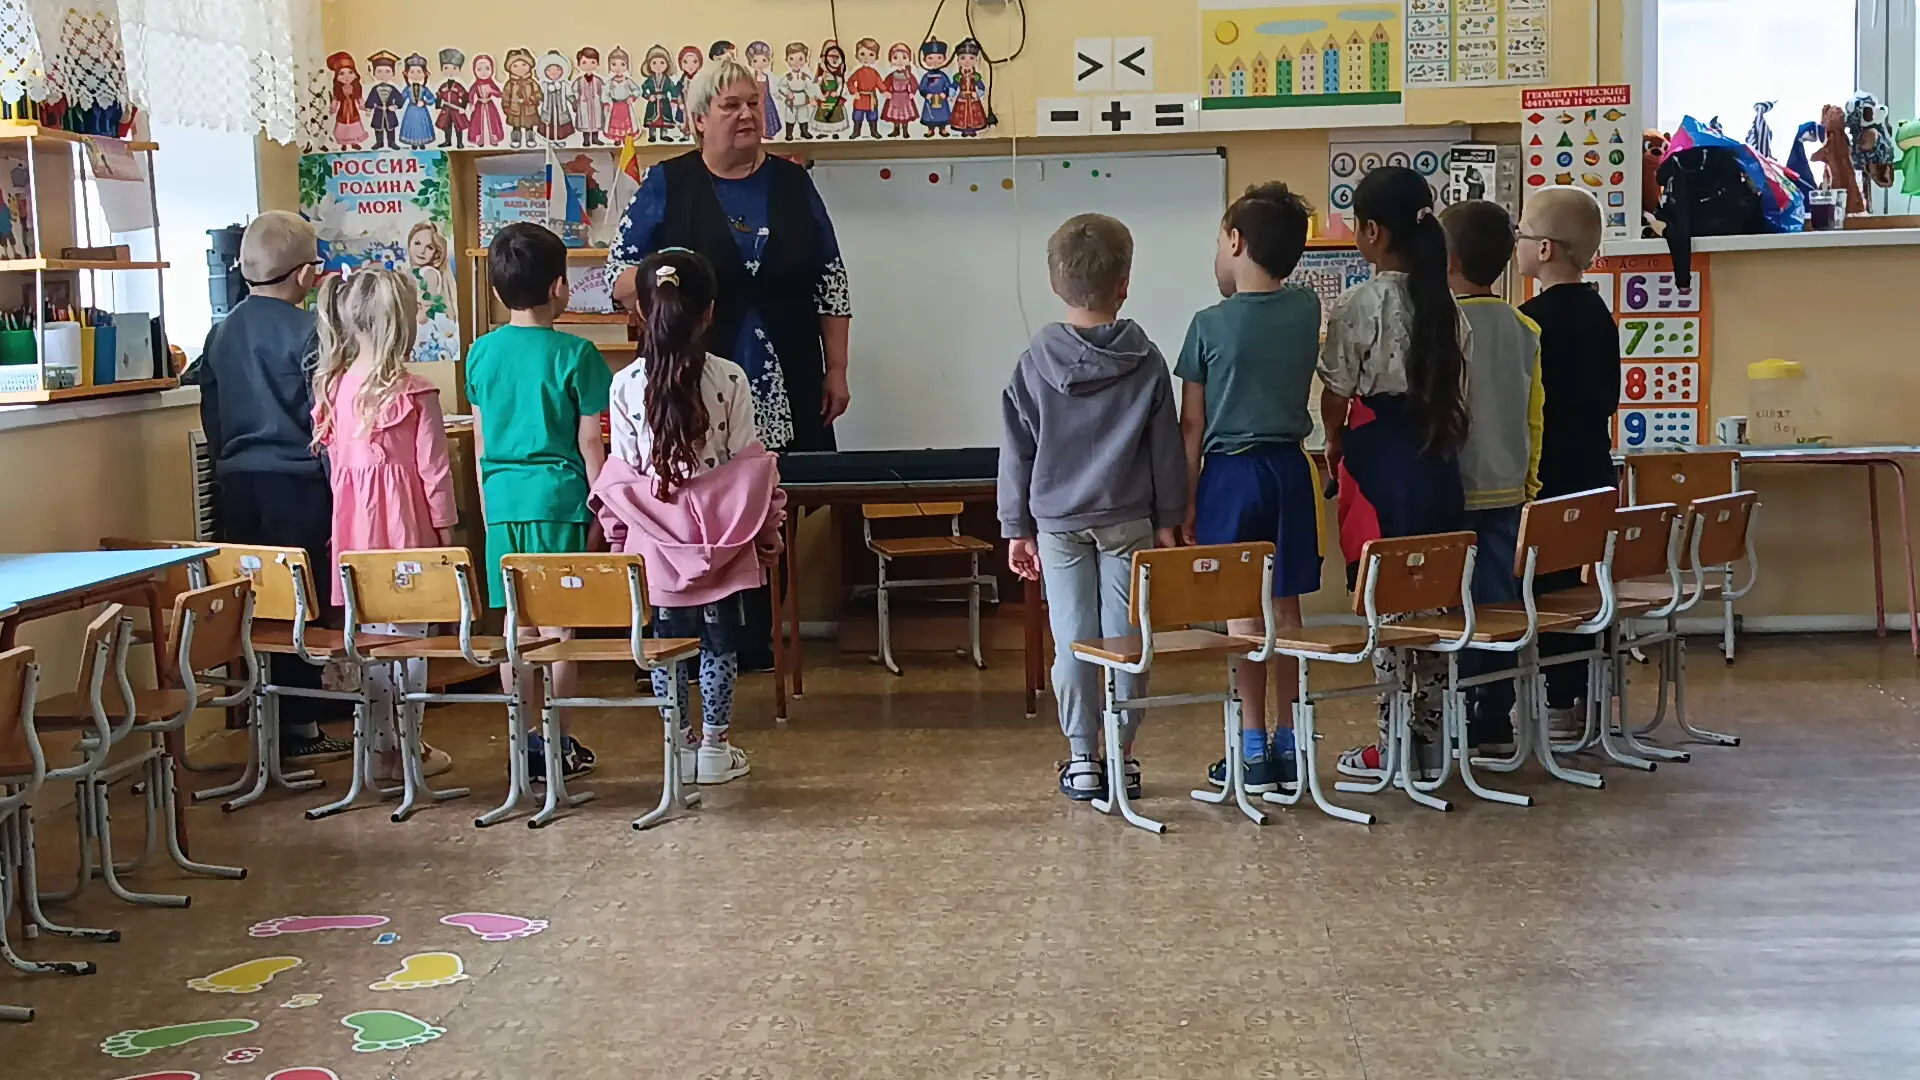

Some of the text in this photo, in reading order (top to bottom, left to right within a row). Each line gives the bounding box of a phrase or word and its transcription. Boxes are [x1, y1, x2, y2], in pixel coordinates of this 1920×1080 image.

[1526, 87, 1626, 100] ГЕОМЕТРИЧЕСКИЕ
[1524, 95, 1627, 108] ФИГУРЫ И ФОРМЫ
[333, 158, 425, 176] РОССИЯ-
[1340, 158, 1347, 171] 1
[1366, 158, 1375, 170] 2
[1420, 157, 1430, 169] 4
[339, 180, 416, 195] РОДИНА
[1340, 190, 1349, 203] 6
[358, 200, 402, 215] МОЯ!
[1626, 275, 1649, 310] 6
[1624, 321, 1649, 355] 7
[1625, 367, 1647, 401] 8
[1624, 411, 1647, 446] 9
[441, 554, 449, 566] 2
